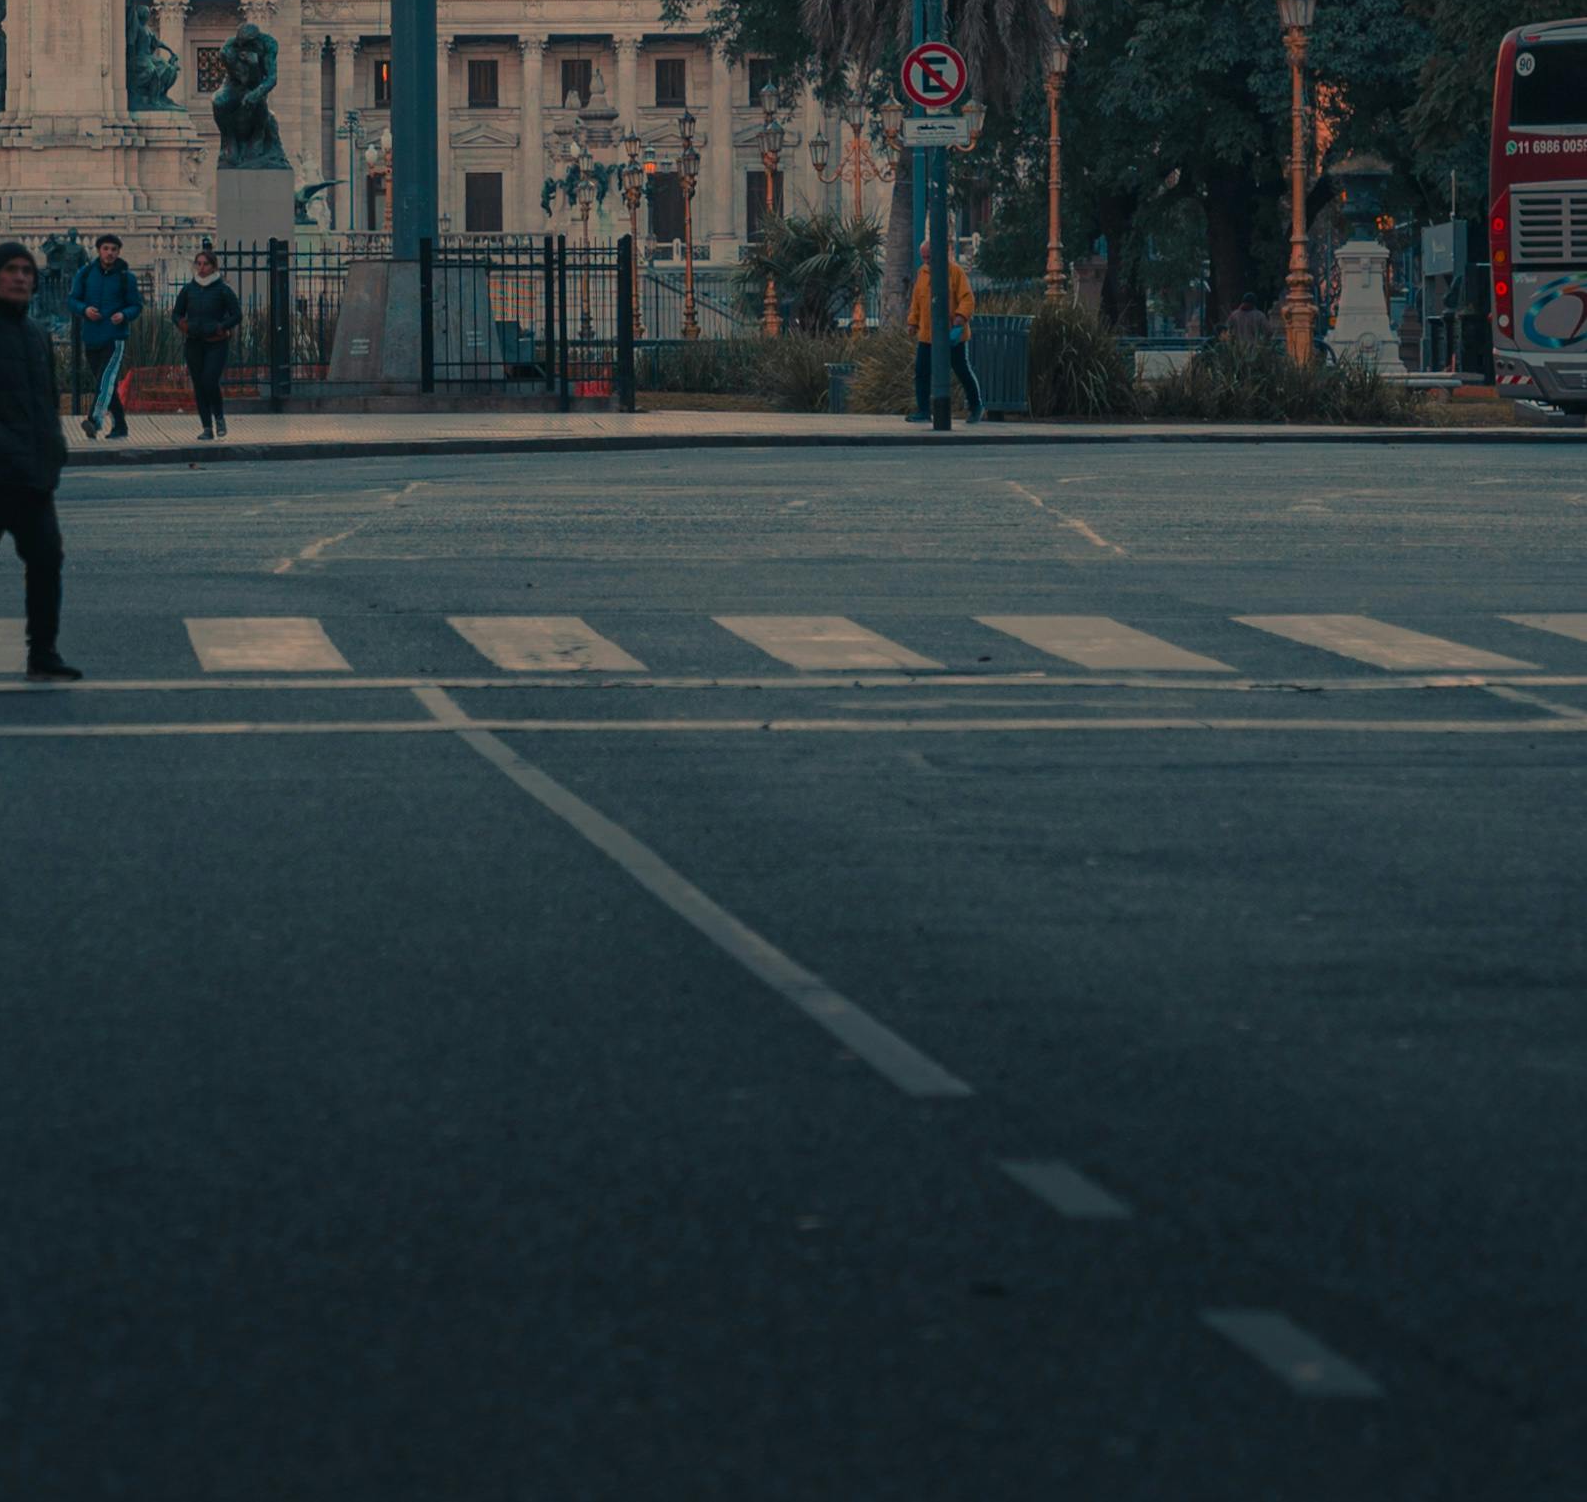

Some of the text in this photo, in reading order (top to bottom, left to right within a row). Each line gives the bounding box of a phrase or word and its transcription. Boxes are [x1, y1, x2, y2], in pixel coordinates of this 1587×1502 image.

[1519, 57, 1532, 71] 90
[923, 57, 947, 93] E
[1517, 141, 1530, 154] 11
[1533, 139, 1561, 154] 6986
